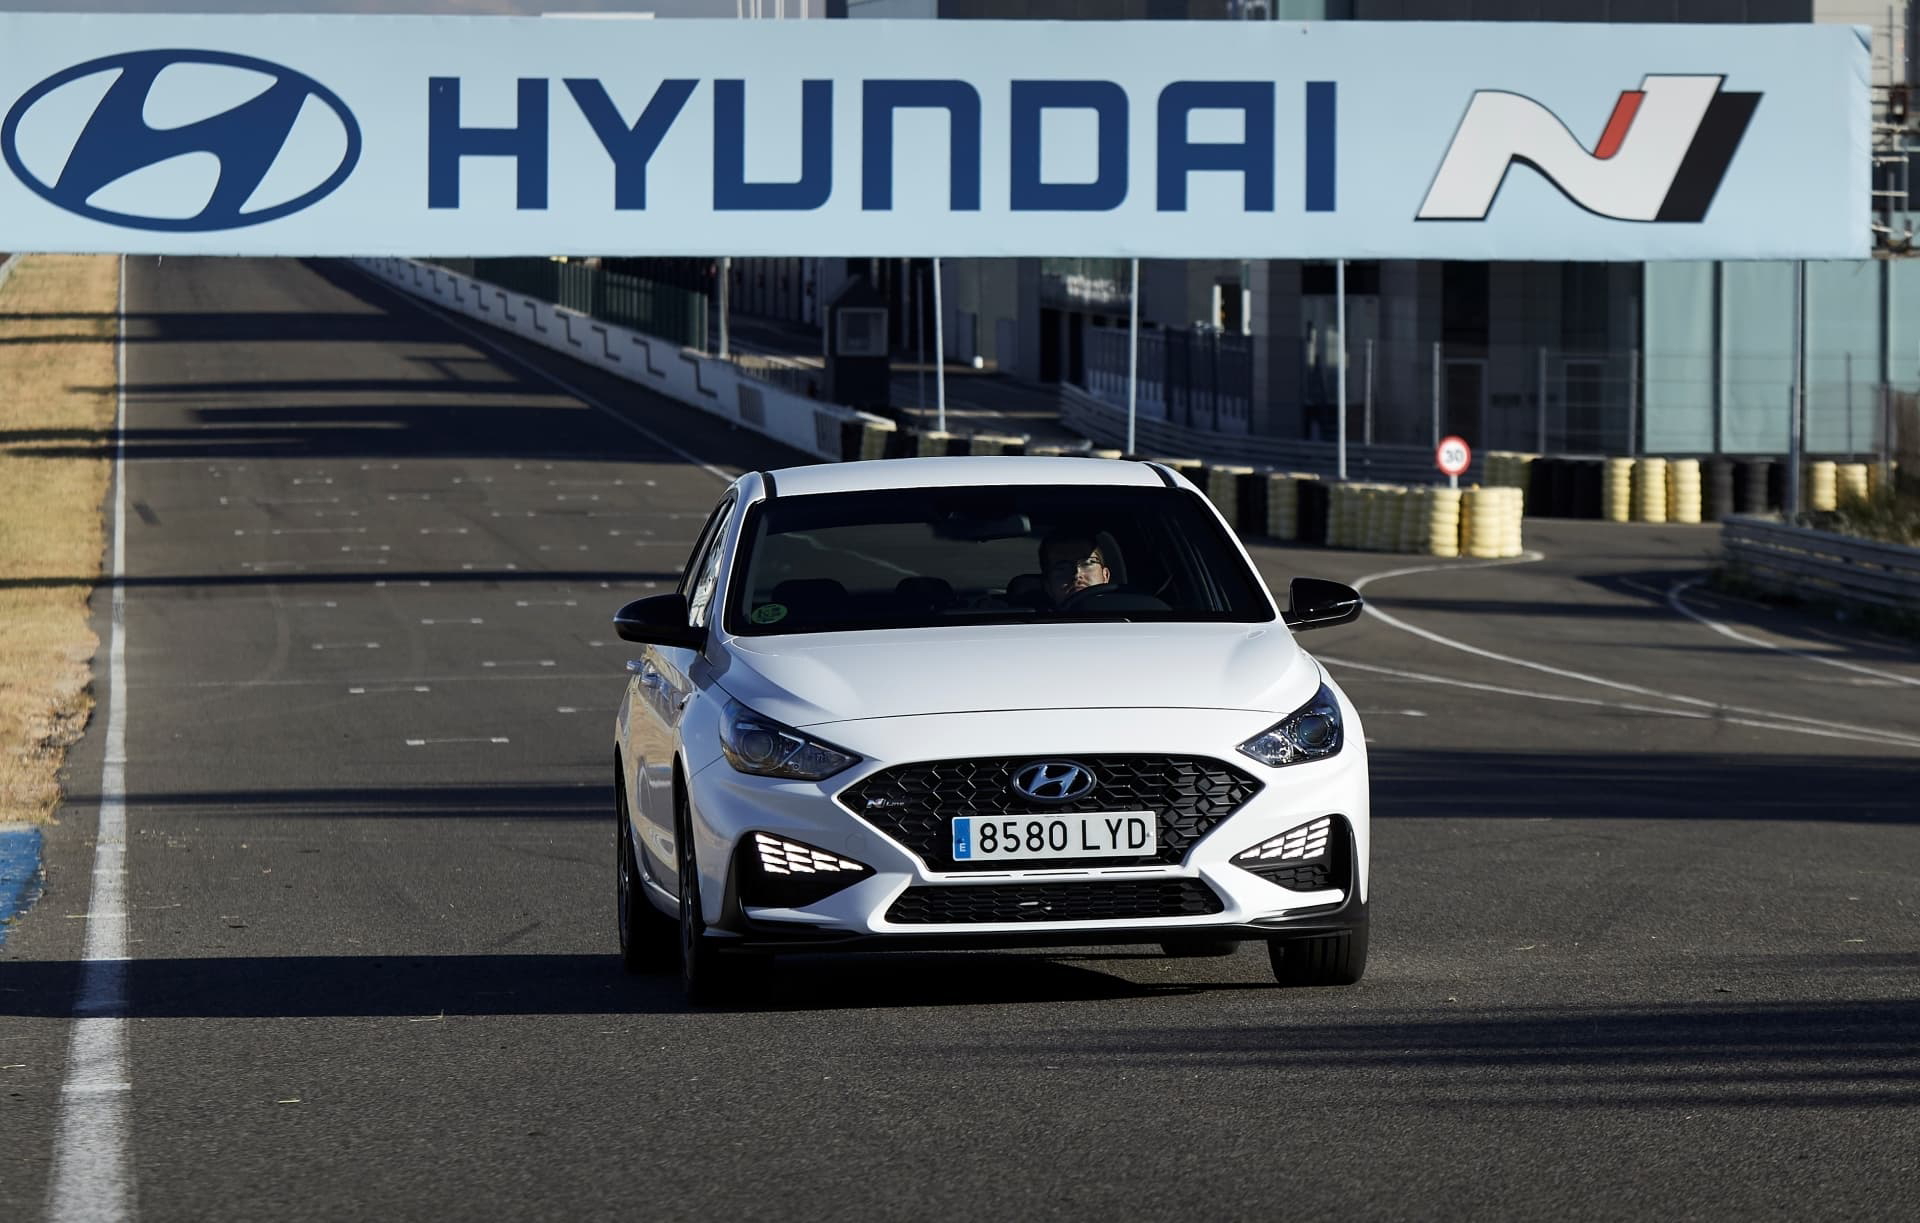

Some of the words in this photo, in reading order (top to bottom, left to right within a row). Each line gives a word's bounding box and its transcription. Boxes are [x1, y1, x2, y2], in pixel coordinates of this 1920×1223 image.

[428, 76, 1336, 212] HYUNDAI
[1445, 448, 1465, 465] 30
[959, 843, 967, 852] E
[979, 820, 1068, 854] 8580
[1081, 818, 1146, 851] LYD
